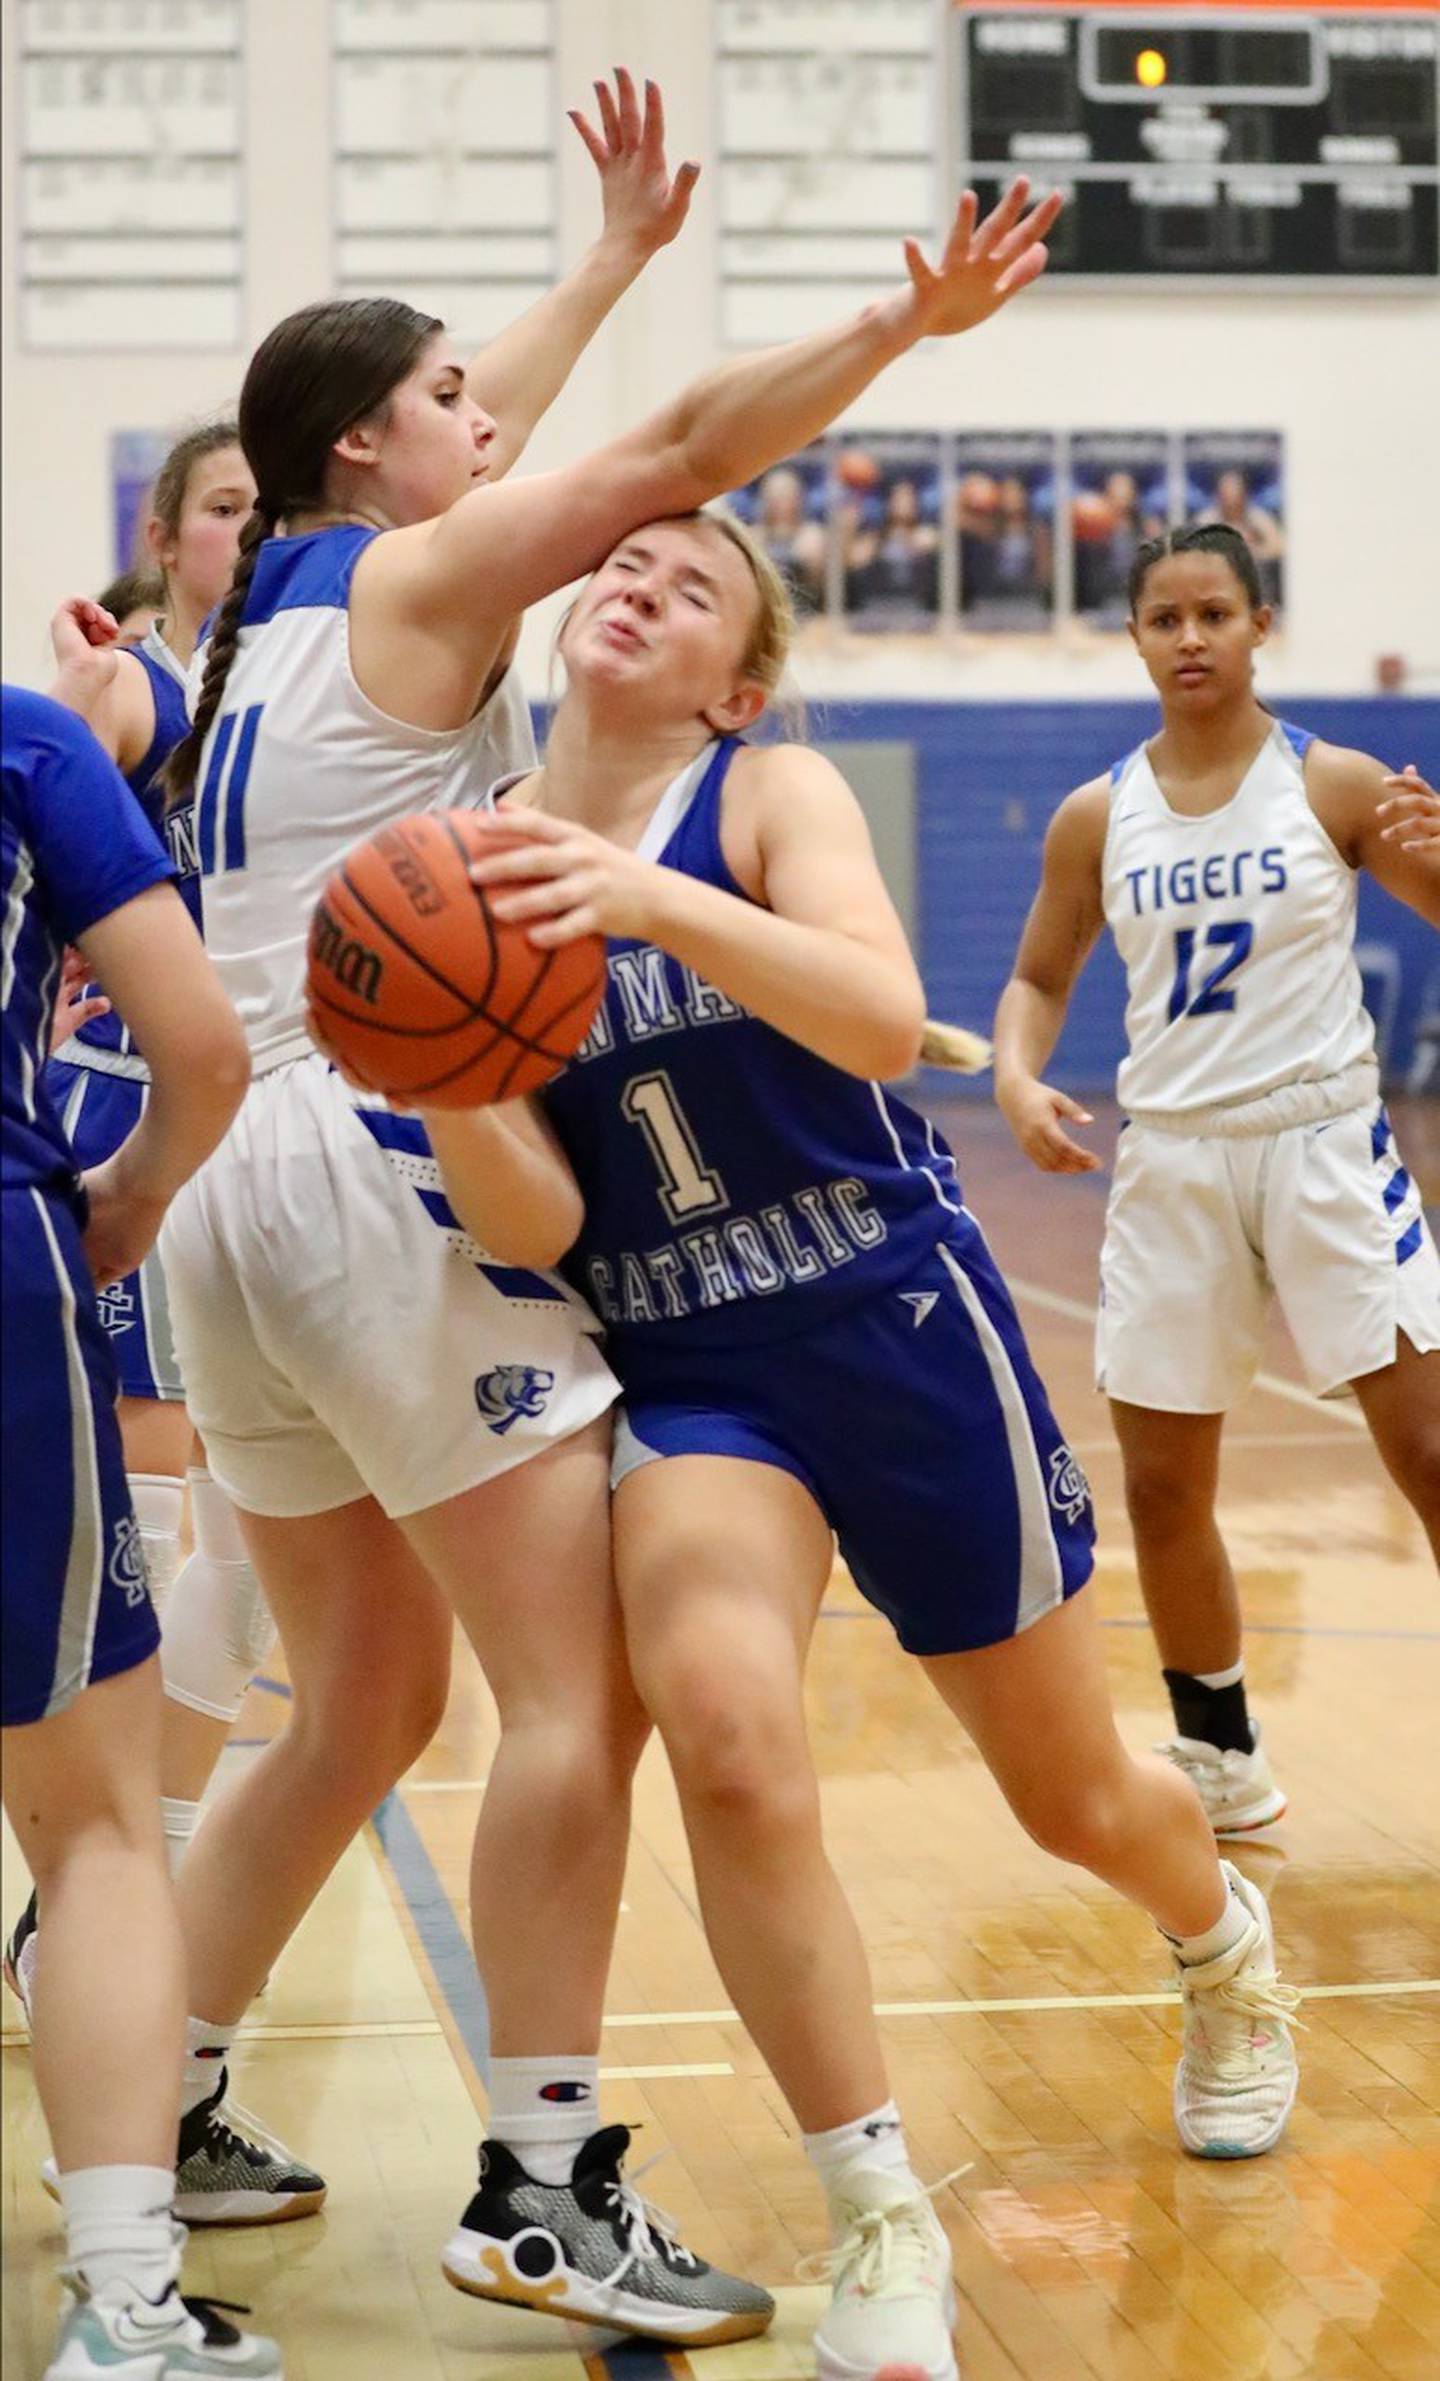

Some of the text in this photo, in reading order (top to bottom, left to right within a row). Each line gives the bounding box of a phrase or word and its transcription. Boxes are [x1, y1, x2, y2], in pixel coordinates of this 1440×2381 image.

[199, 704, 264, 876] 11
[1126, 848, 1287, 915] TIGERS
[1167, 919, 1254, 1025] 12
[620, 1069, 731, 1227] 1
[588, 1176, 887, 1322] CATHOLIC
